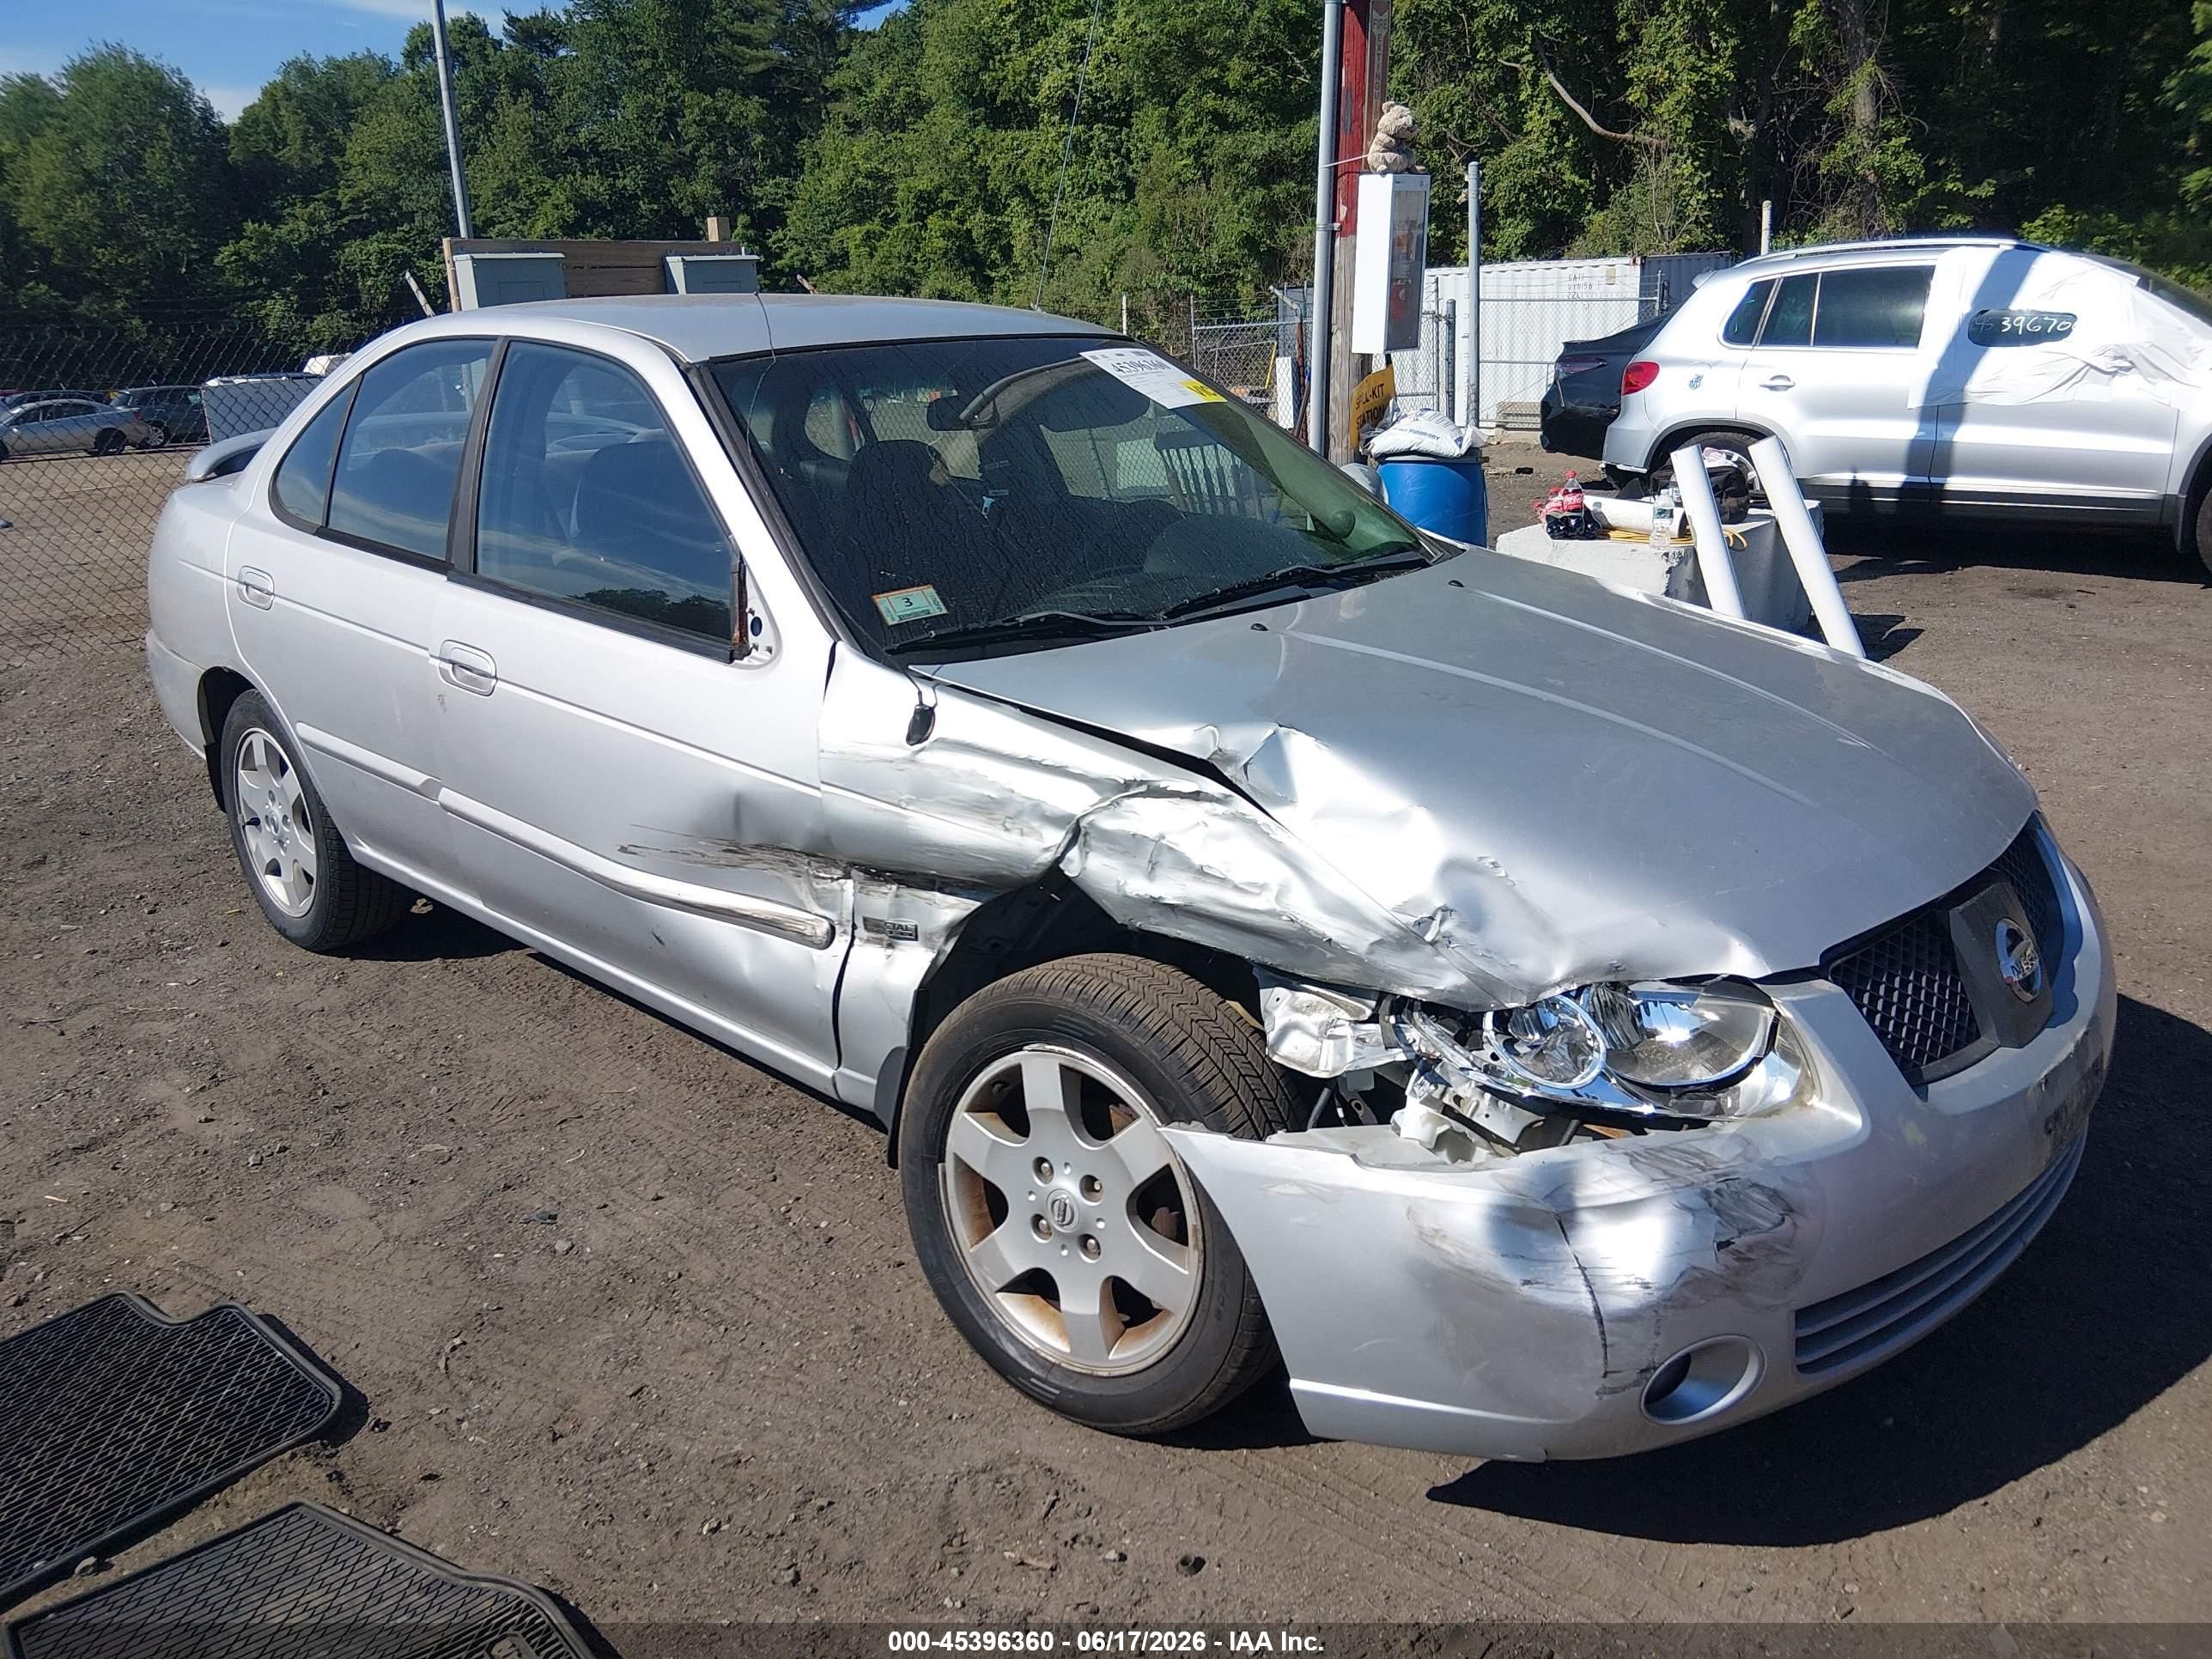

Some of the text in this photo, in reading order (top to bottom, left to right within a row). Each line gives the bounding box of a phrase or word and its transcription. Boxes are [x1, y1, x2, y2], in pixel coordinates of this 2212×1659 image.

[2000, 315, 2076, 336] 39670
[1109, 359, 1171, 374] 45396360
[1355, 383, 1385, 410] SPL-KIT
[1356, 404, 1387, 430] STATION
[901, 597, 914, 607] 3
